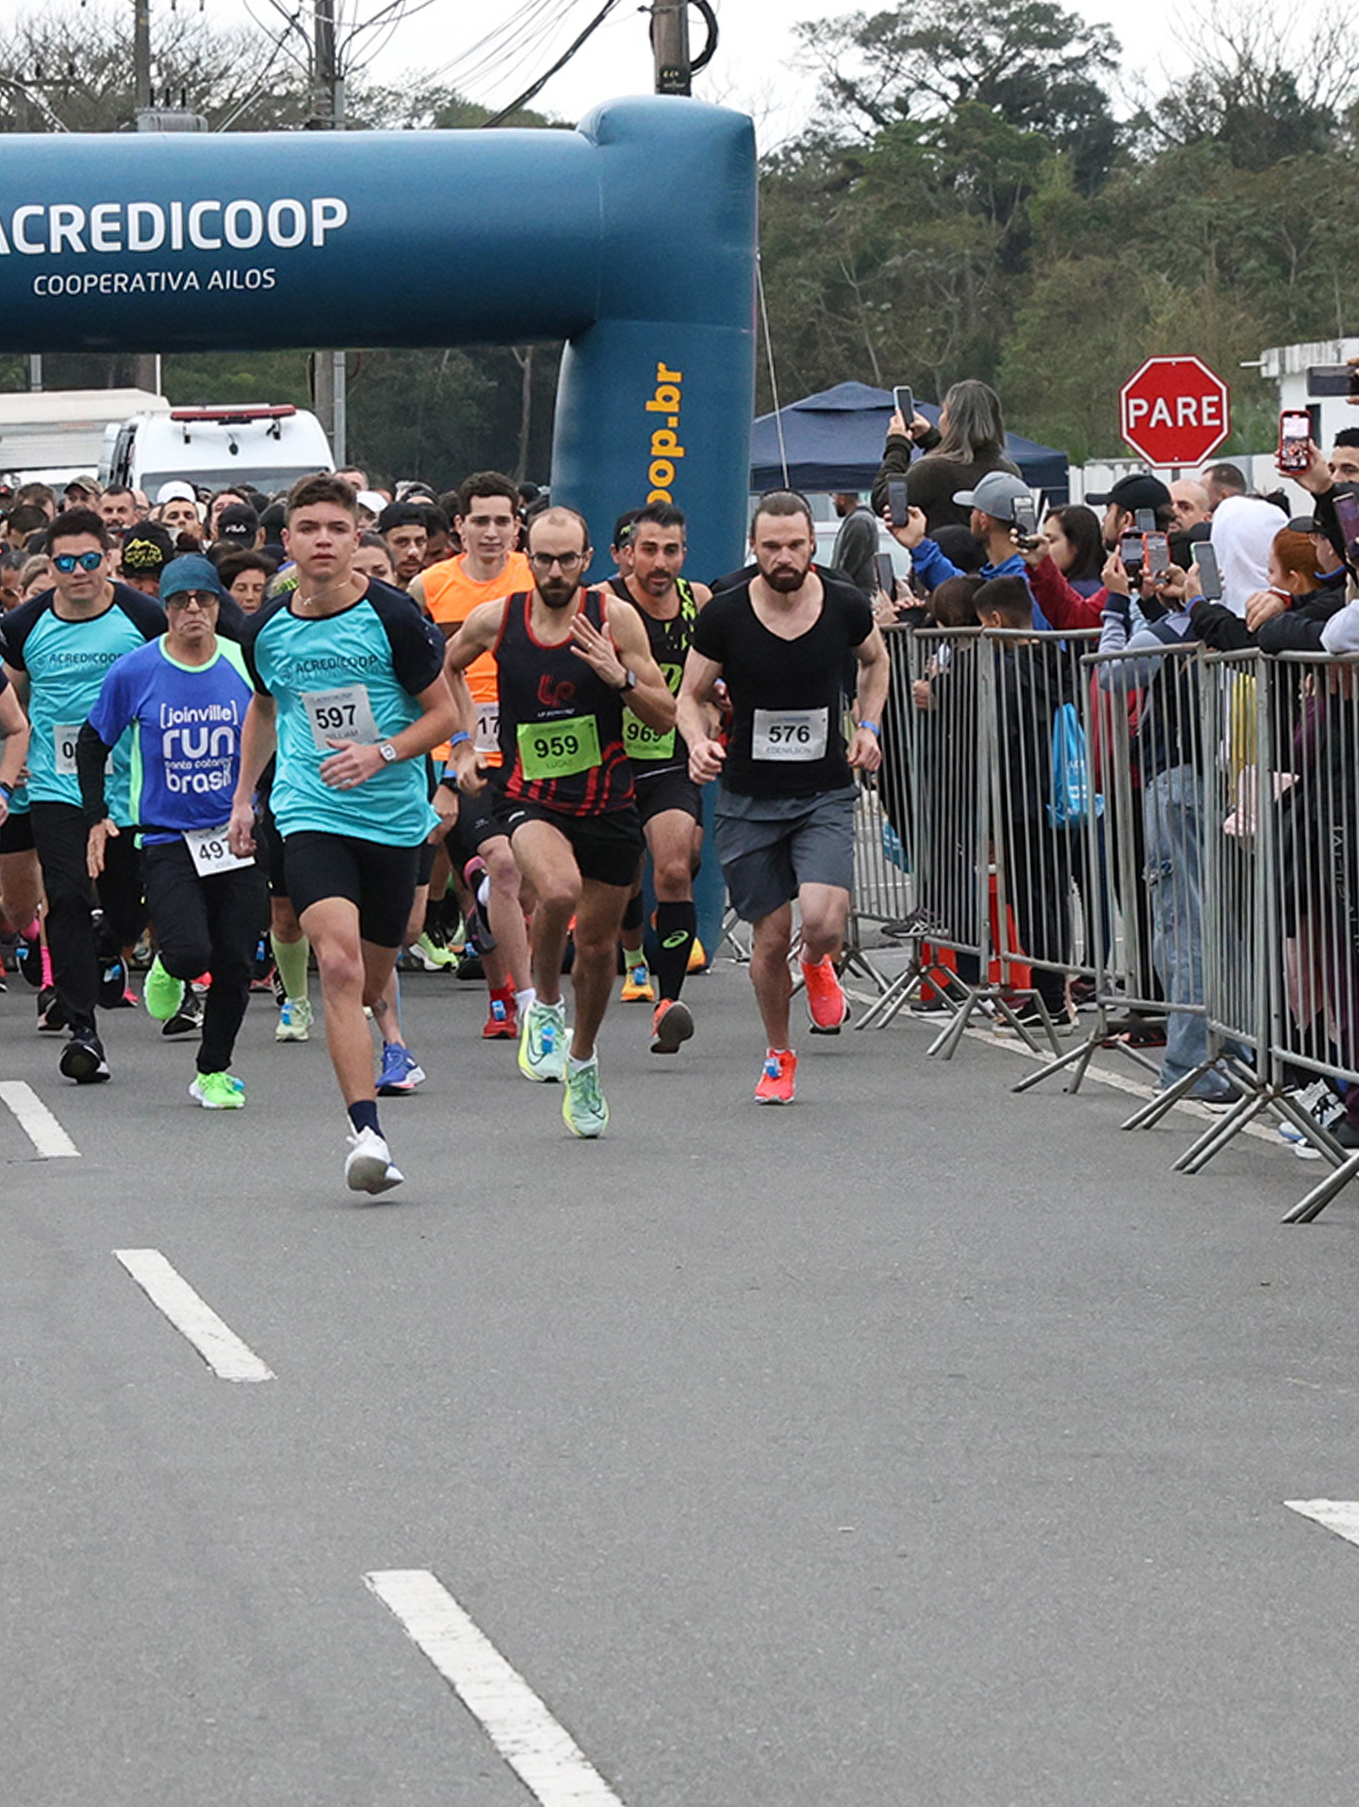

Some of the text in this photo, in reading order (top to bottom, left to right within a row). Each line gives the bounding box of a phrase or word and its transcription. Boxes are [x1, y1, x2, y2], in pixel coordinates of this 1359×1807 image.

[33, 268, 277, 296] COOPERATIVA AILOS
[1127, 395, 1221, 429] PARE
[315, 704, 356, 729] 597
[162, 725, 235, 760] run
[534, 735, 579, 758] 959
[768, 725, 810, 743] 576
[199, 839, 229, 861] 49
